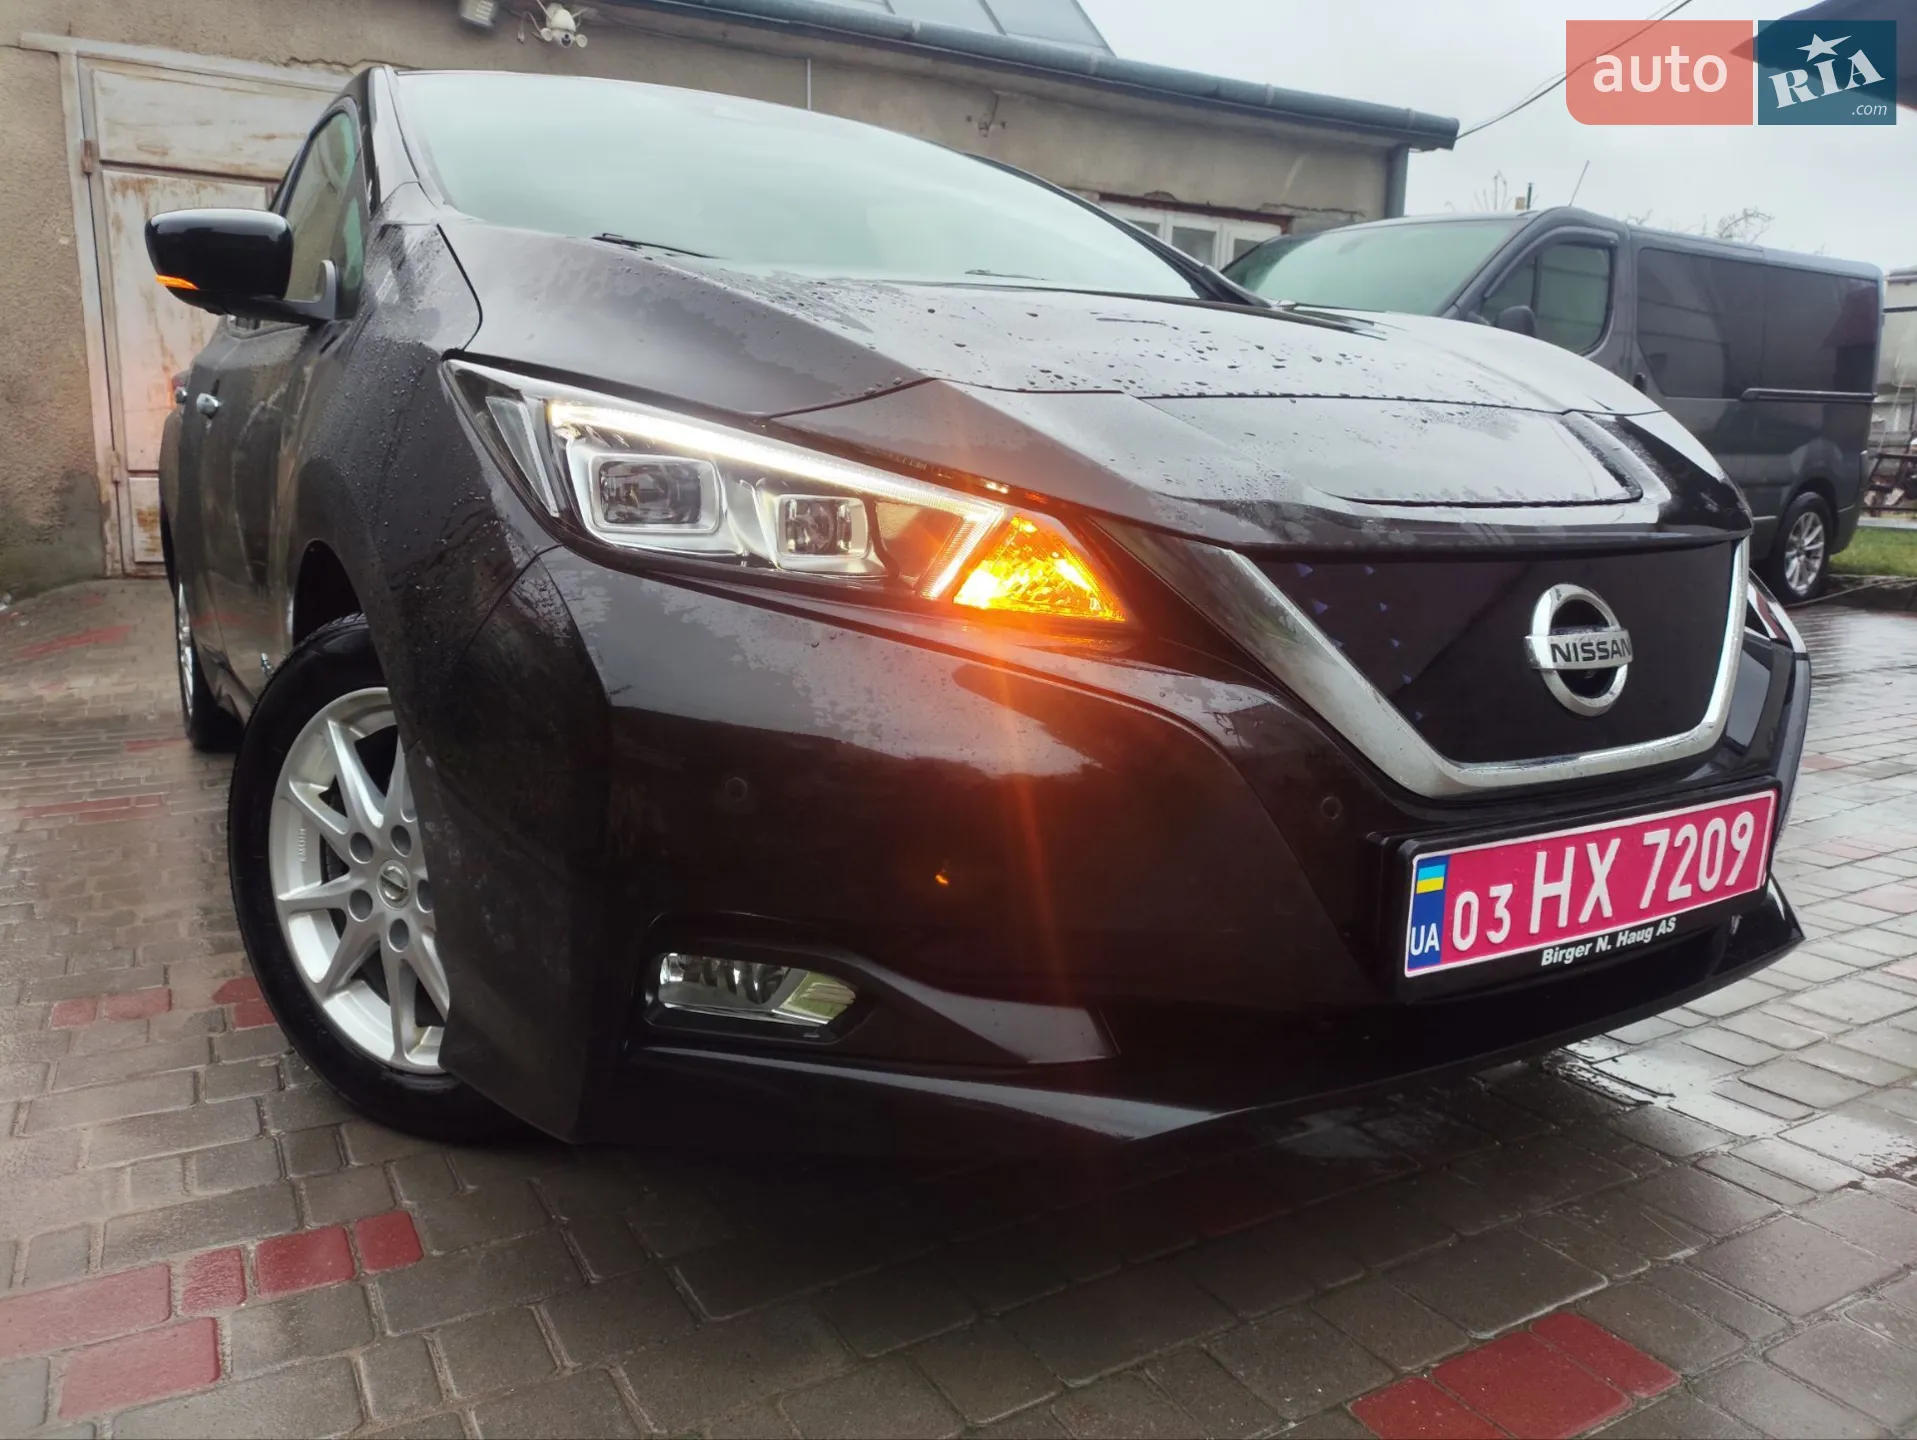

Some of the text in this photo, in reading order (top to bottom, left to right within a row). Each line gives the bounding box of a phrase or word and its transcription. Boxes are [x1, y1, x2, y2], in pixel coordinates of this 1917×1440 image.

[1550, 637, 1632, 663] NISSAN
[1451, 811, 1755, 952] 03 HX 7209
[1410, 922, 1440, 956] UA
[1541, 917, 1677, 966] Birger N. Haug AS
